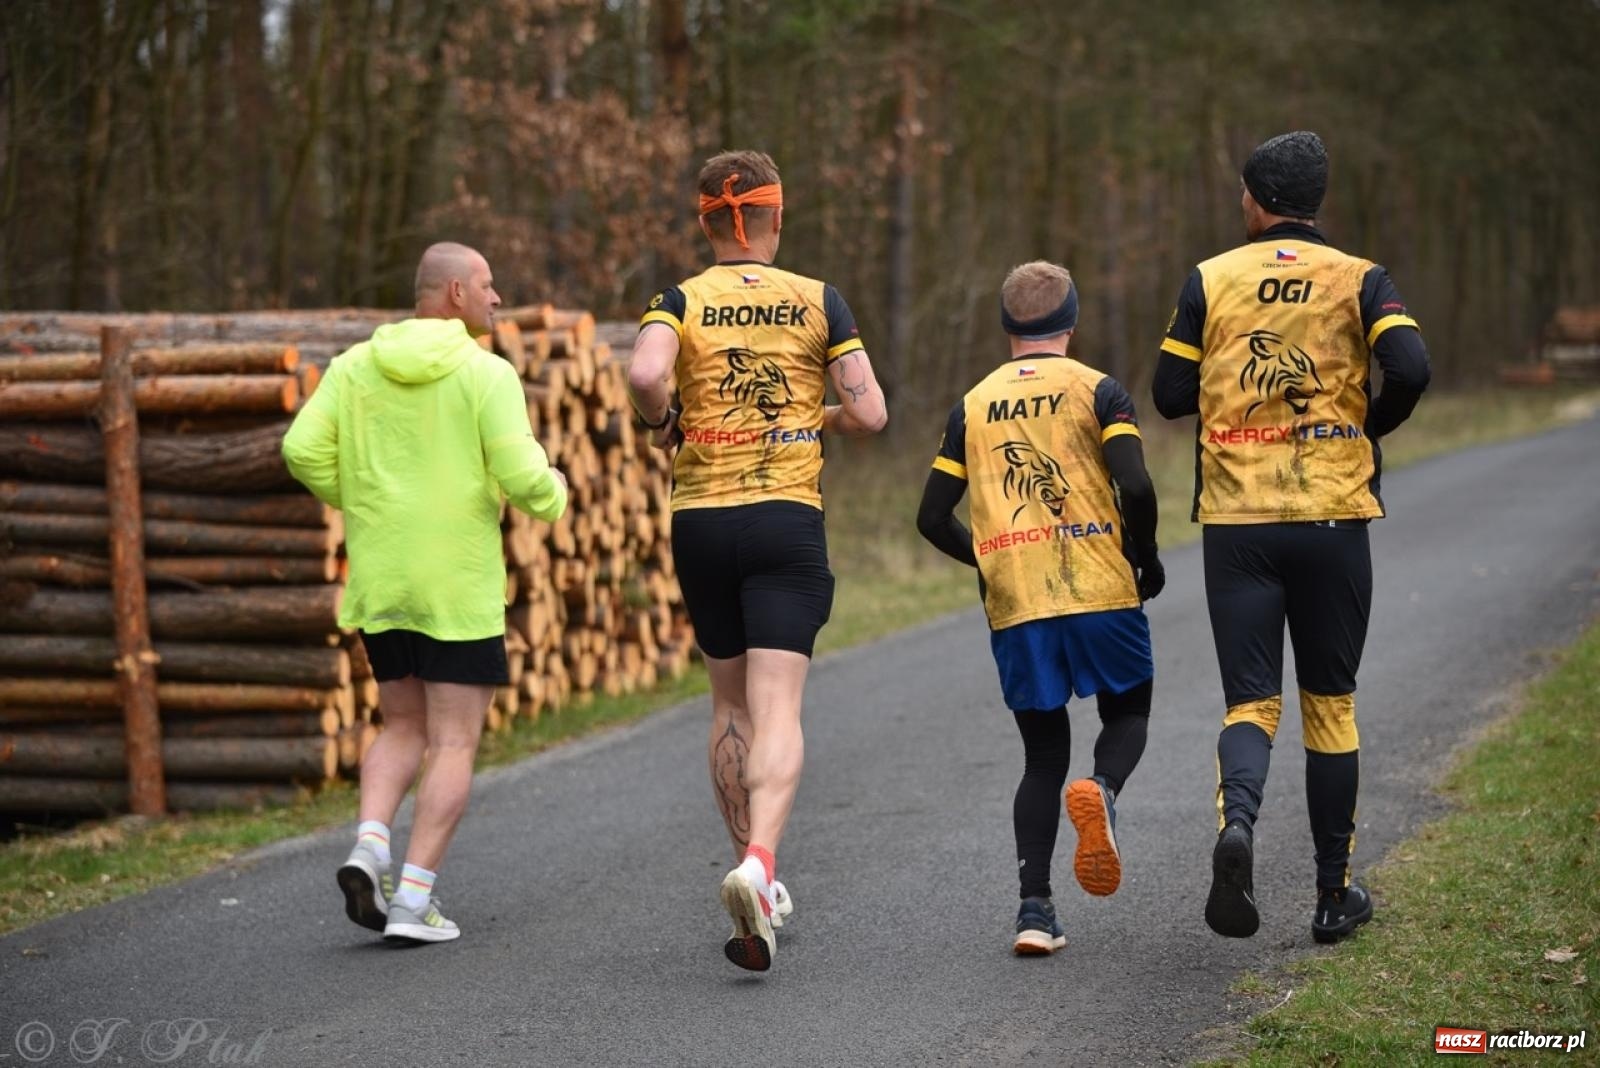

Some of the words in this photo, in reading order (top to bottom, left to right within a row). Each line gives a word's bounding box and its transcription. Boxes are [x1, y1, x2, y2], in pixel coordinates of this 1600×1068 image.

[1257, 278, 1313, 304] OGI
[701, 300, 809, 327] BRONĚK
[987, 392, 1064, 424] MATY
[769, 427, 823, 443] TEAM
[1299, 423, 1362, 440] TEAM
[979, 525, 1054, 556] ENERGY
[1061, 521, 1114, 539] TEAM
